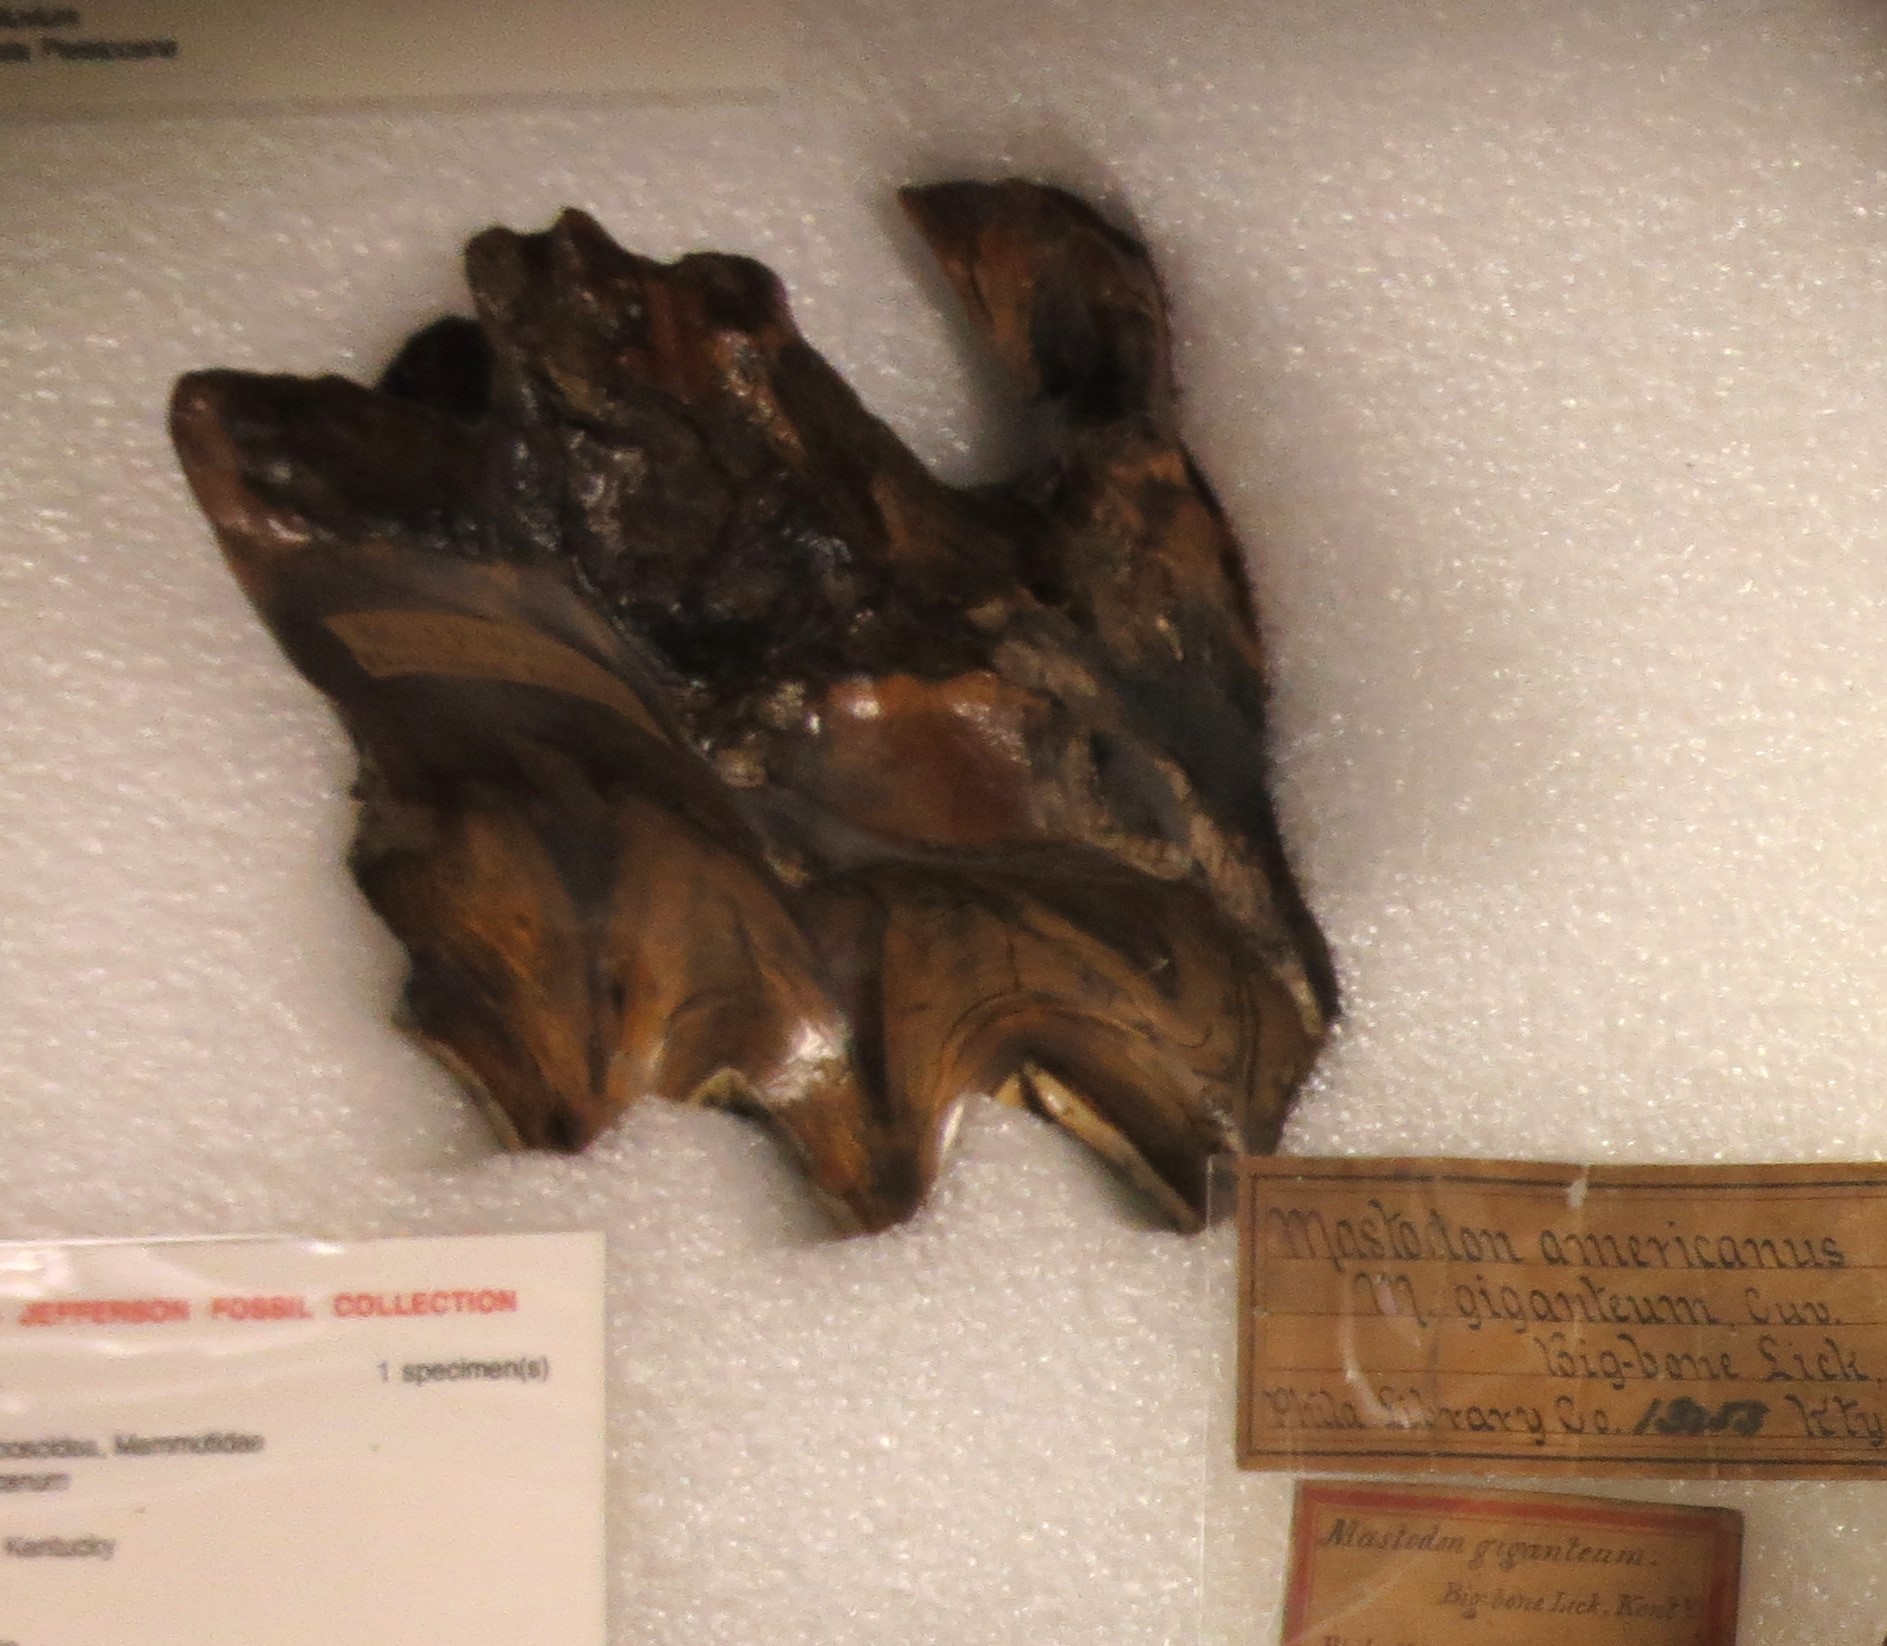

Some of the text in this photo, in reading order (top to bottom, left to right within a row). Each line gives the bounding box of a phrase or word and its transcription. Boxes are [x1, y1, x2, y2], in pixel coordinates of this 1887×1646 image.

[1269, 1198, 1847, 1273] Mastodon americanus
[19, 1289, 518, 1327] JEFFERSON FOSSIL COLLECTION
[376, 1356, 550, 1387] 1 specimen(s)
[1318, 1518, 1466, 1554] Mastodon
